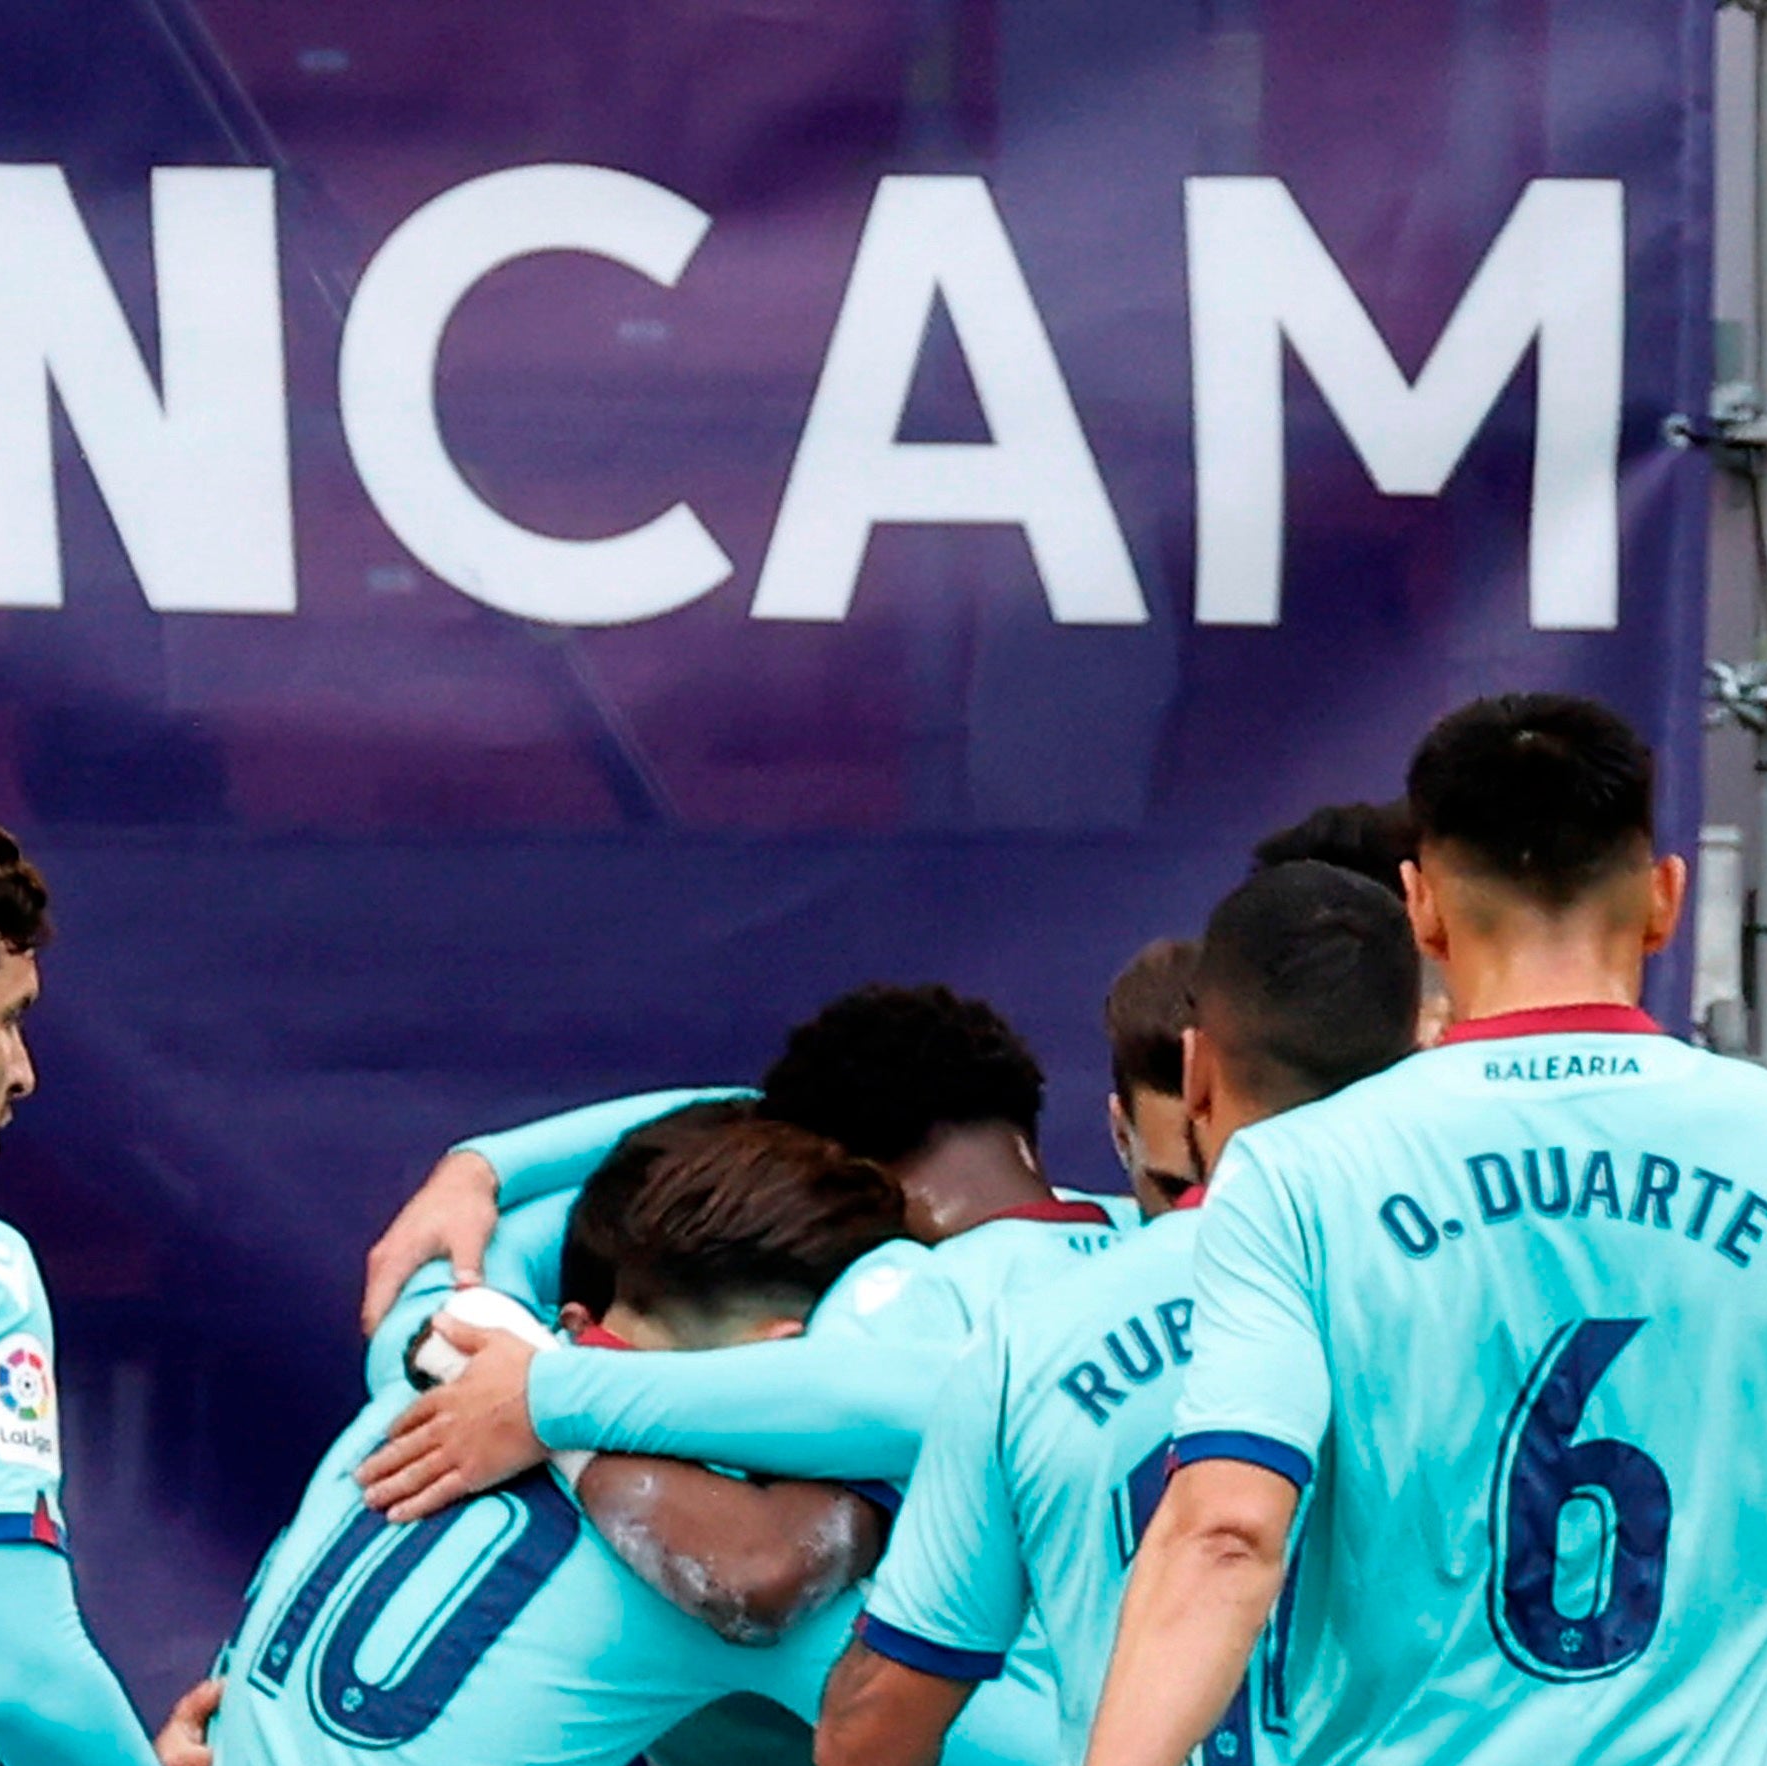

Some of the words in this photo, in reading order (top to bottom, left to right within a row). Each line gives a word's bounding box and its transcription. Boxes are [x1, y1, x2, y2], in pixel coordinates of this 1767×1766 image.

[1377, 1192, 1465, 1260] O.
[247, 1462, 581, 1751] 10
[1487, 1317, 1673, 1684] 6
